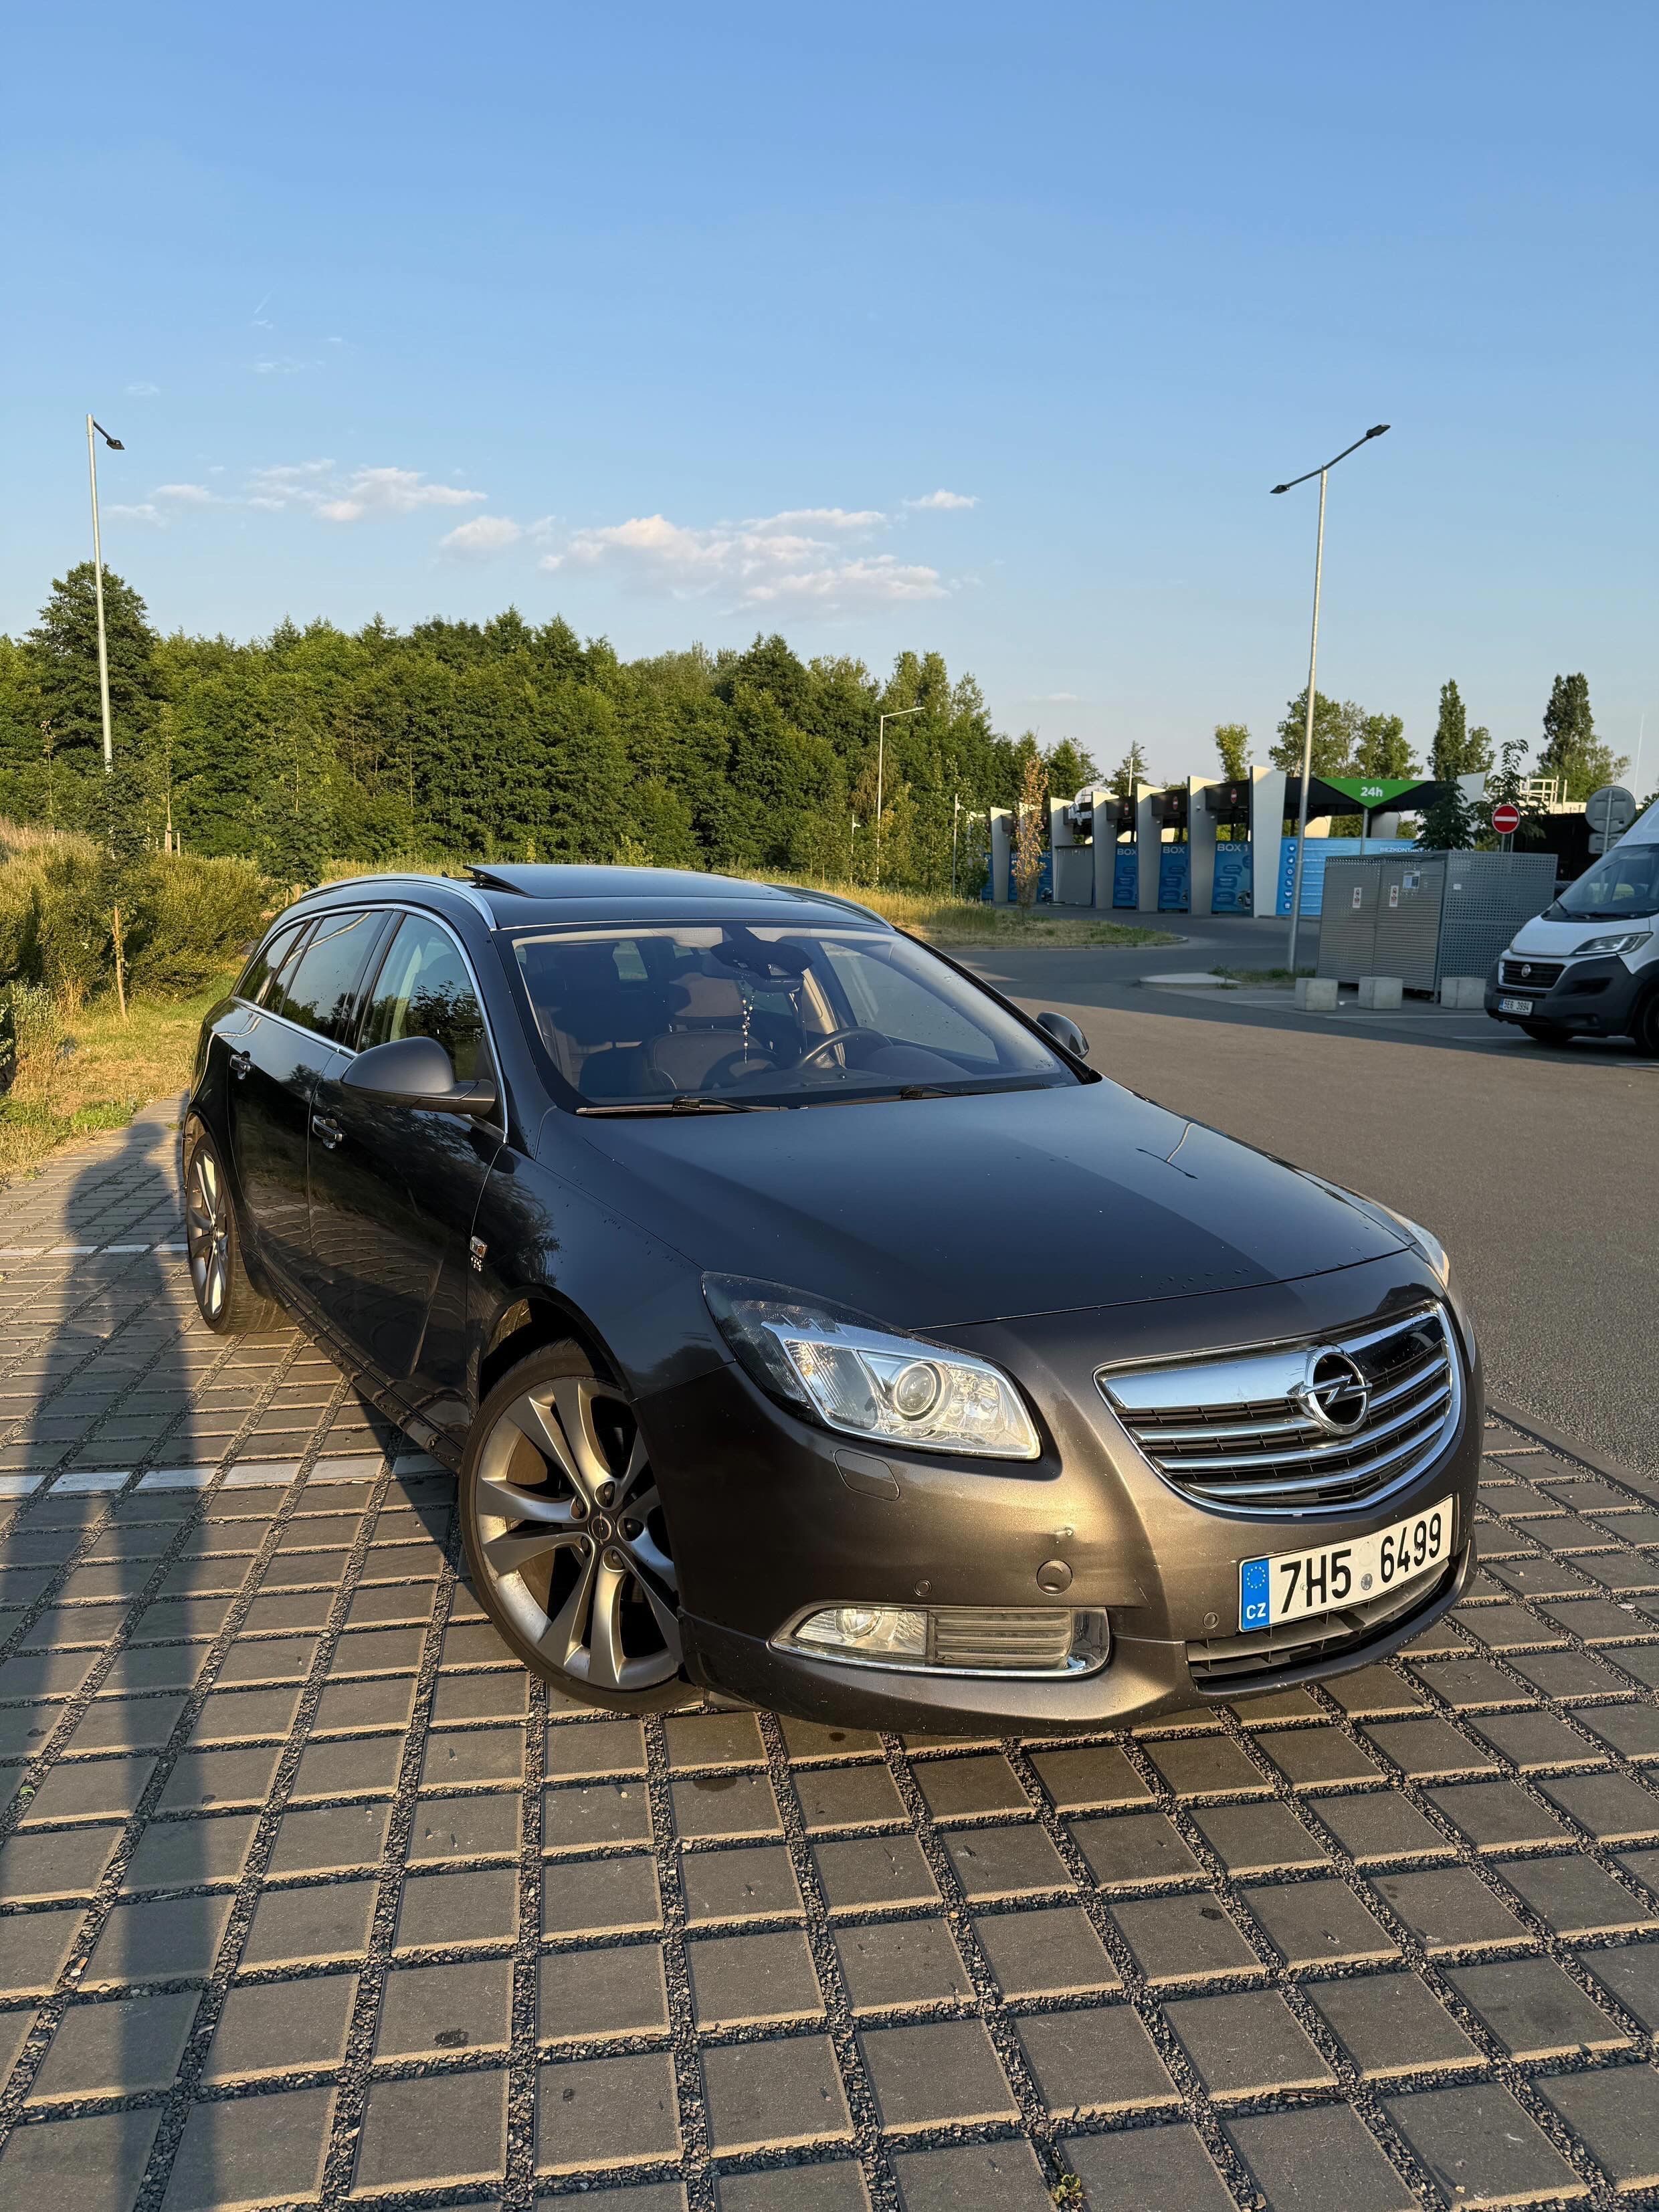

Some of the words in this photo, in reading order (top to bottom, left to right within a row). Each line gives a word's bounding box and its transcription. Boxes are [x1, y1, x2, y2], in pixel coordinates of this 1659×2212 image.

[1360, 786, 1383, 797] 24h
[1163, 846, 1185, 854] BOX
[1217, 843, 1242, 851] BOX
[1244, 843, 1249, 851] 1
[1280, 1548, 1351, 1614] 7H5
[1381, 1513, 1442, 1583] 6499
[1246, 1602, 1266, 1620] CZ
